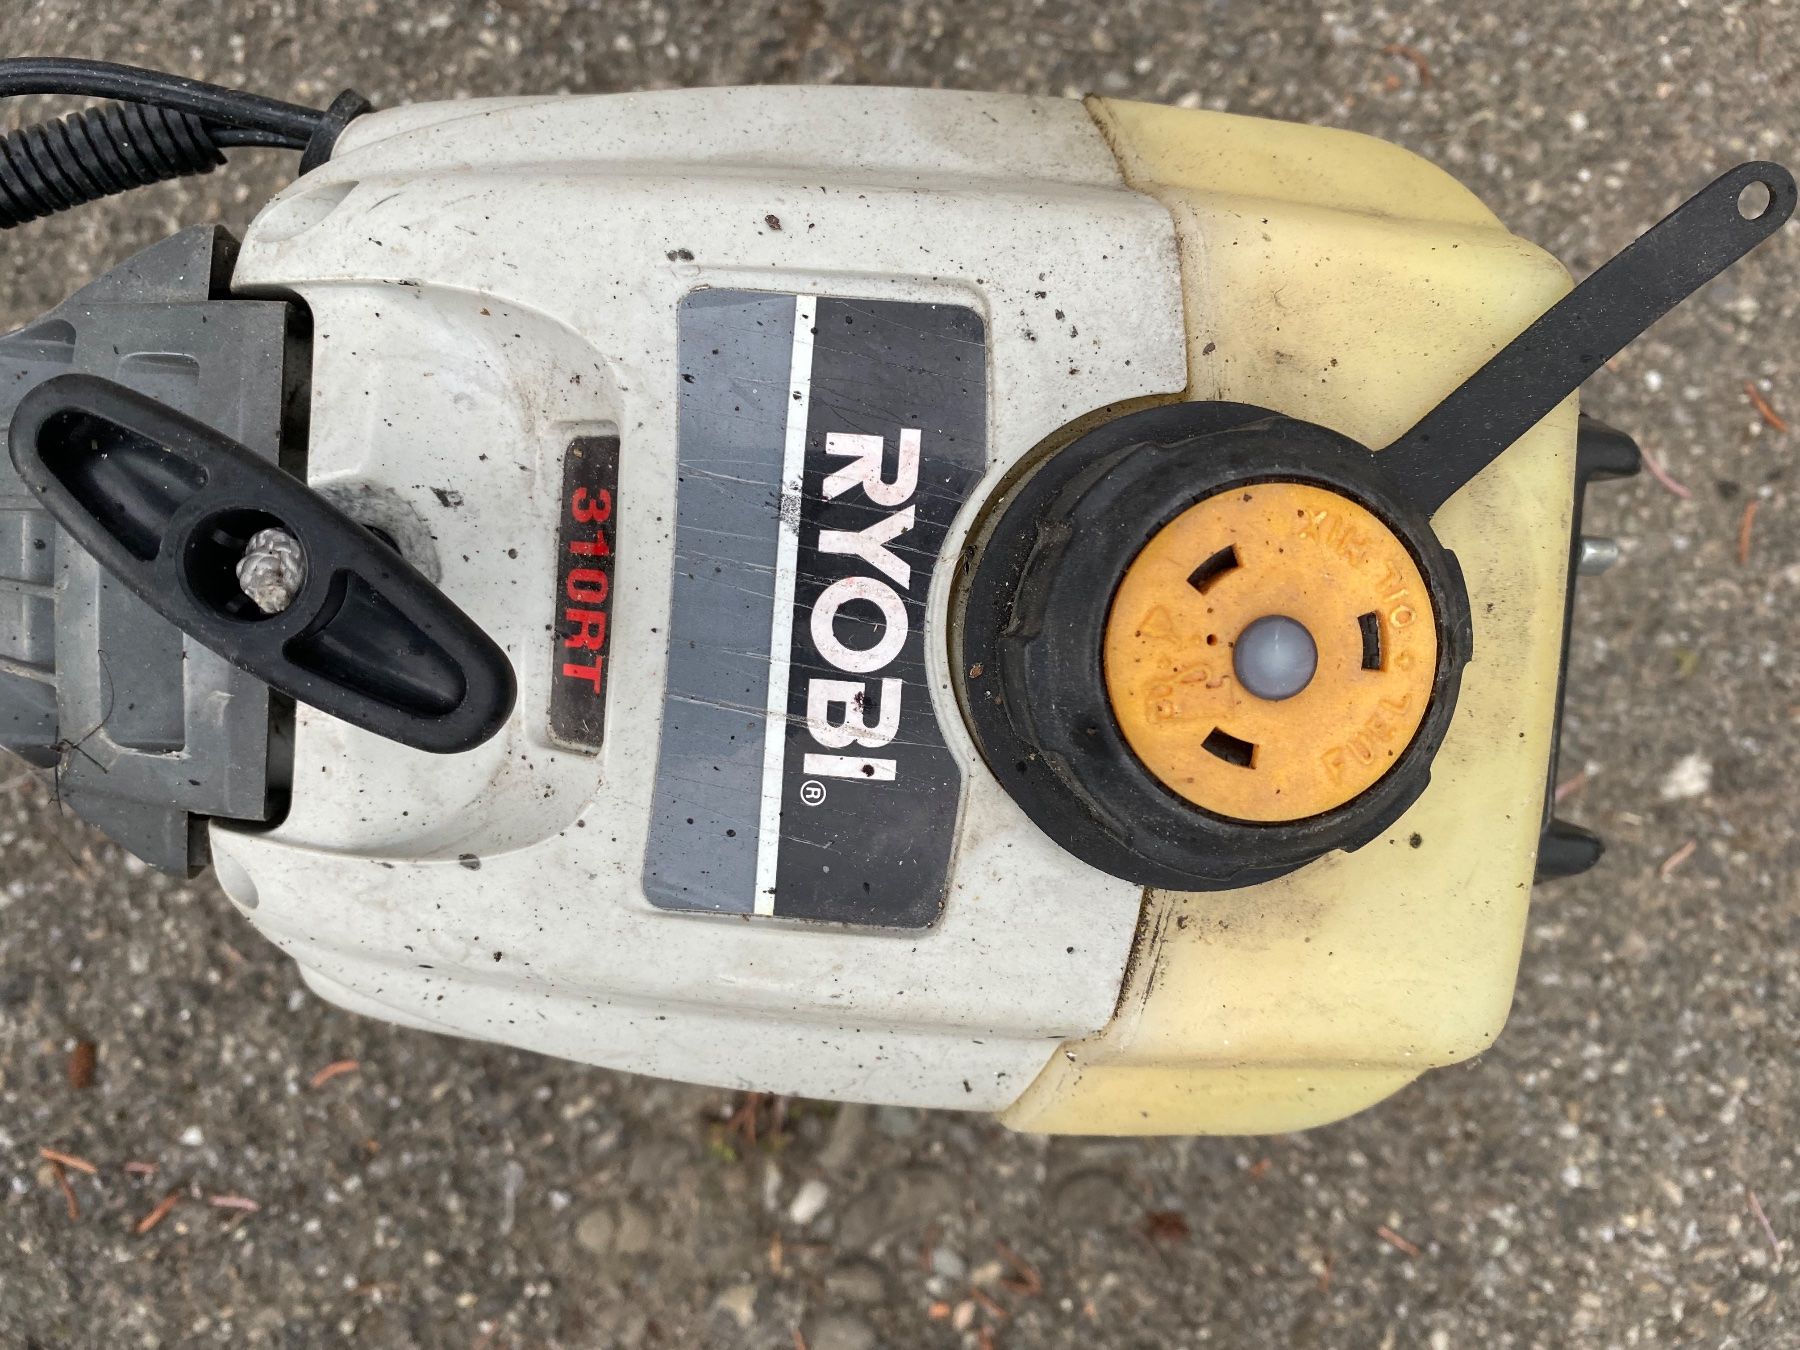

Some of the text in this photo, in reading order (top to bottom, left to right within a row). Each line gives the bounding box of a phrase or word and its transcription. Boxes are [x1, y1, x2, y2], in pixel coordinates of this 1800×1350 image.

[1299, 508, 1370, 569] MIX
[562, 486, 612, 695] 310RT
[803, 428, 922, 781] RYOBI
[1375, 560, 1417, 629] OIL
[1321, 692, 1412, 785] FUEL
